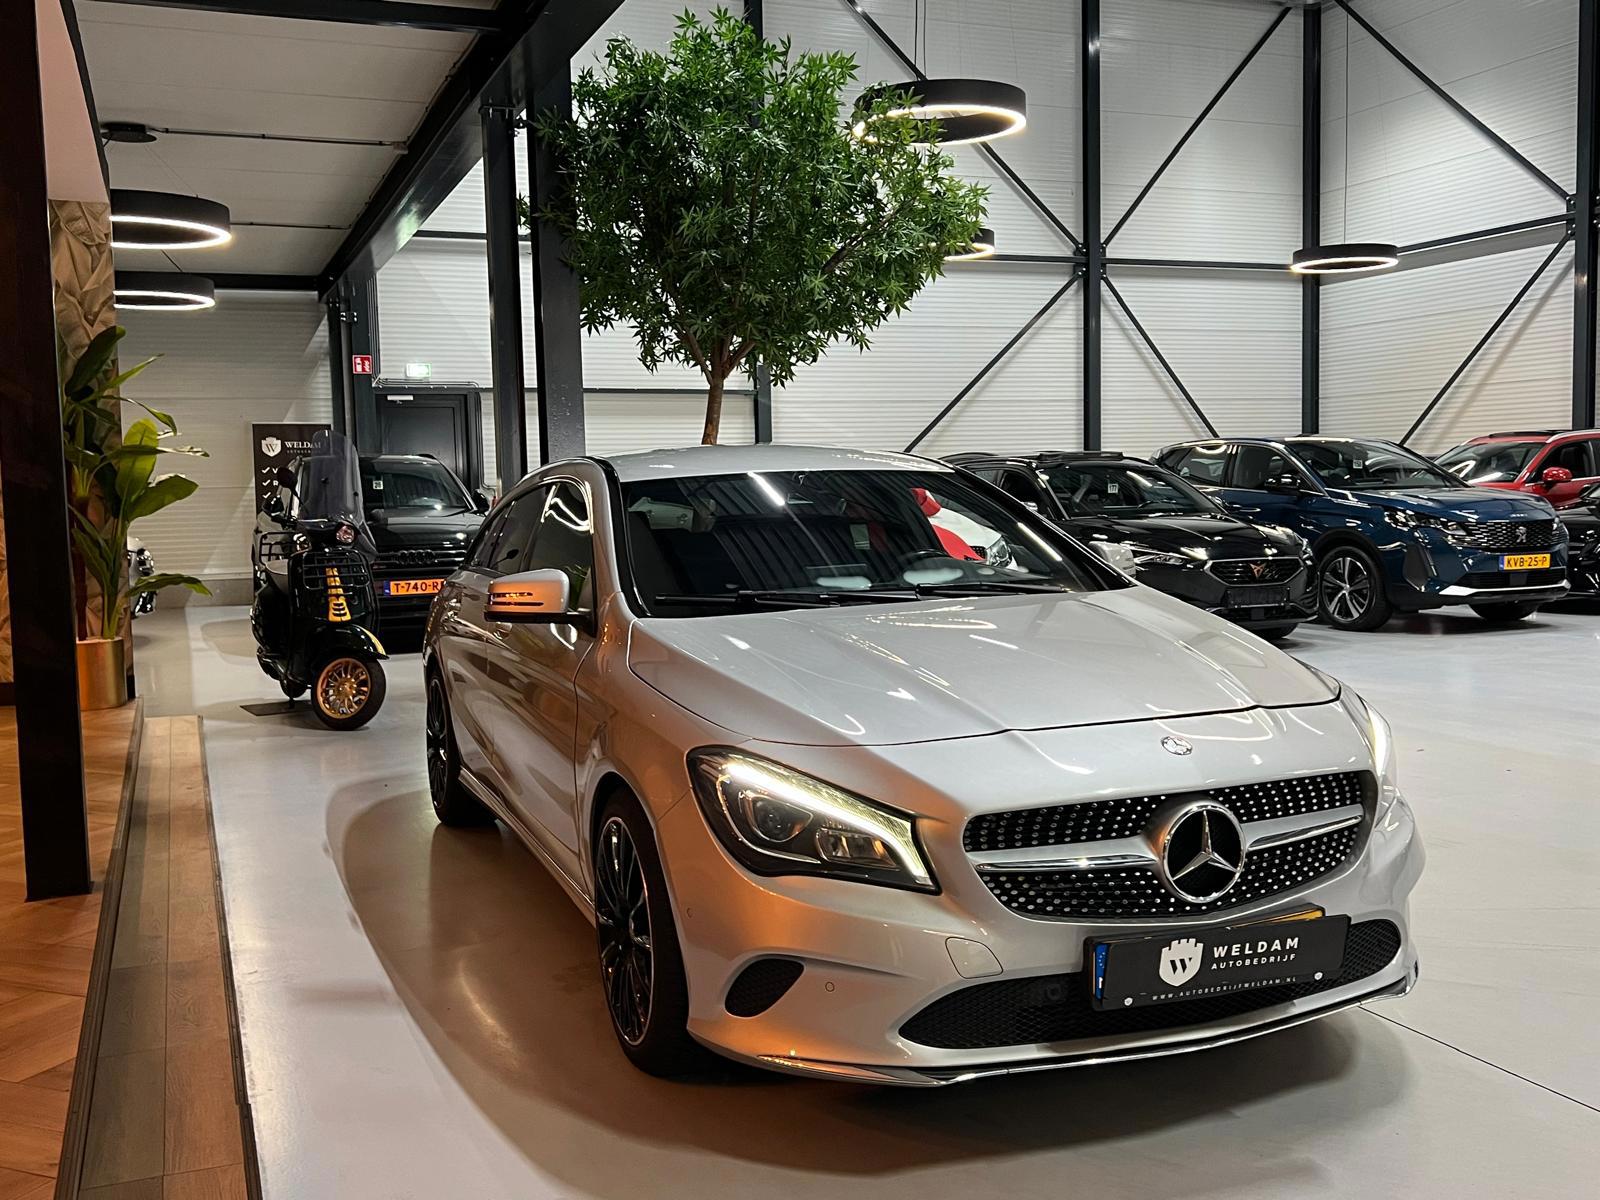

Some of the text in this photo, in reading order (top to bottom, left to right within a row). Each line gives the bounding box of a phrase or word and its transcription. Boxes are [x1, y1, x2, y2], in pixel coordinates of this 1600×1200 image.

[284, 441, 321, 449] WELDAM
[1506, 556, 1547, 568] KVB-25-P
[394, 581, 444, 593] T-740-R
[1213, 937, 1299, 959] WELDAM
[1169, 957, 1193, 976] W
[1211, 953, 1296, 970] AUTOBEDRIJF
[1152, 976, 1296, 1001] WWW.AUTOBEDRIJFWELDAM.NL
